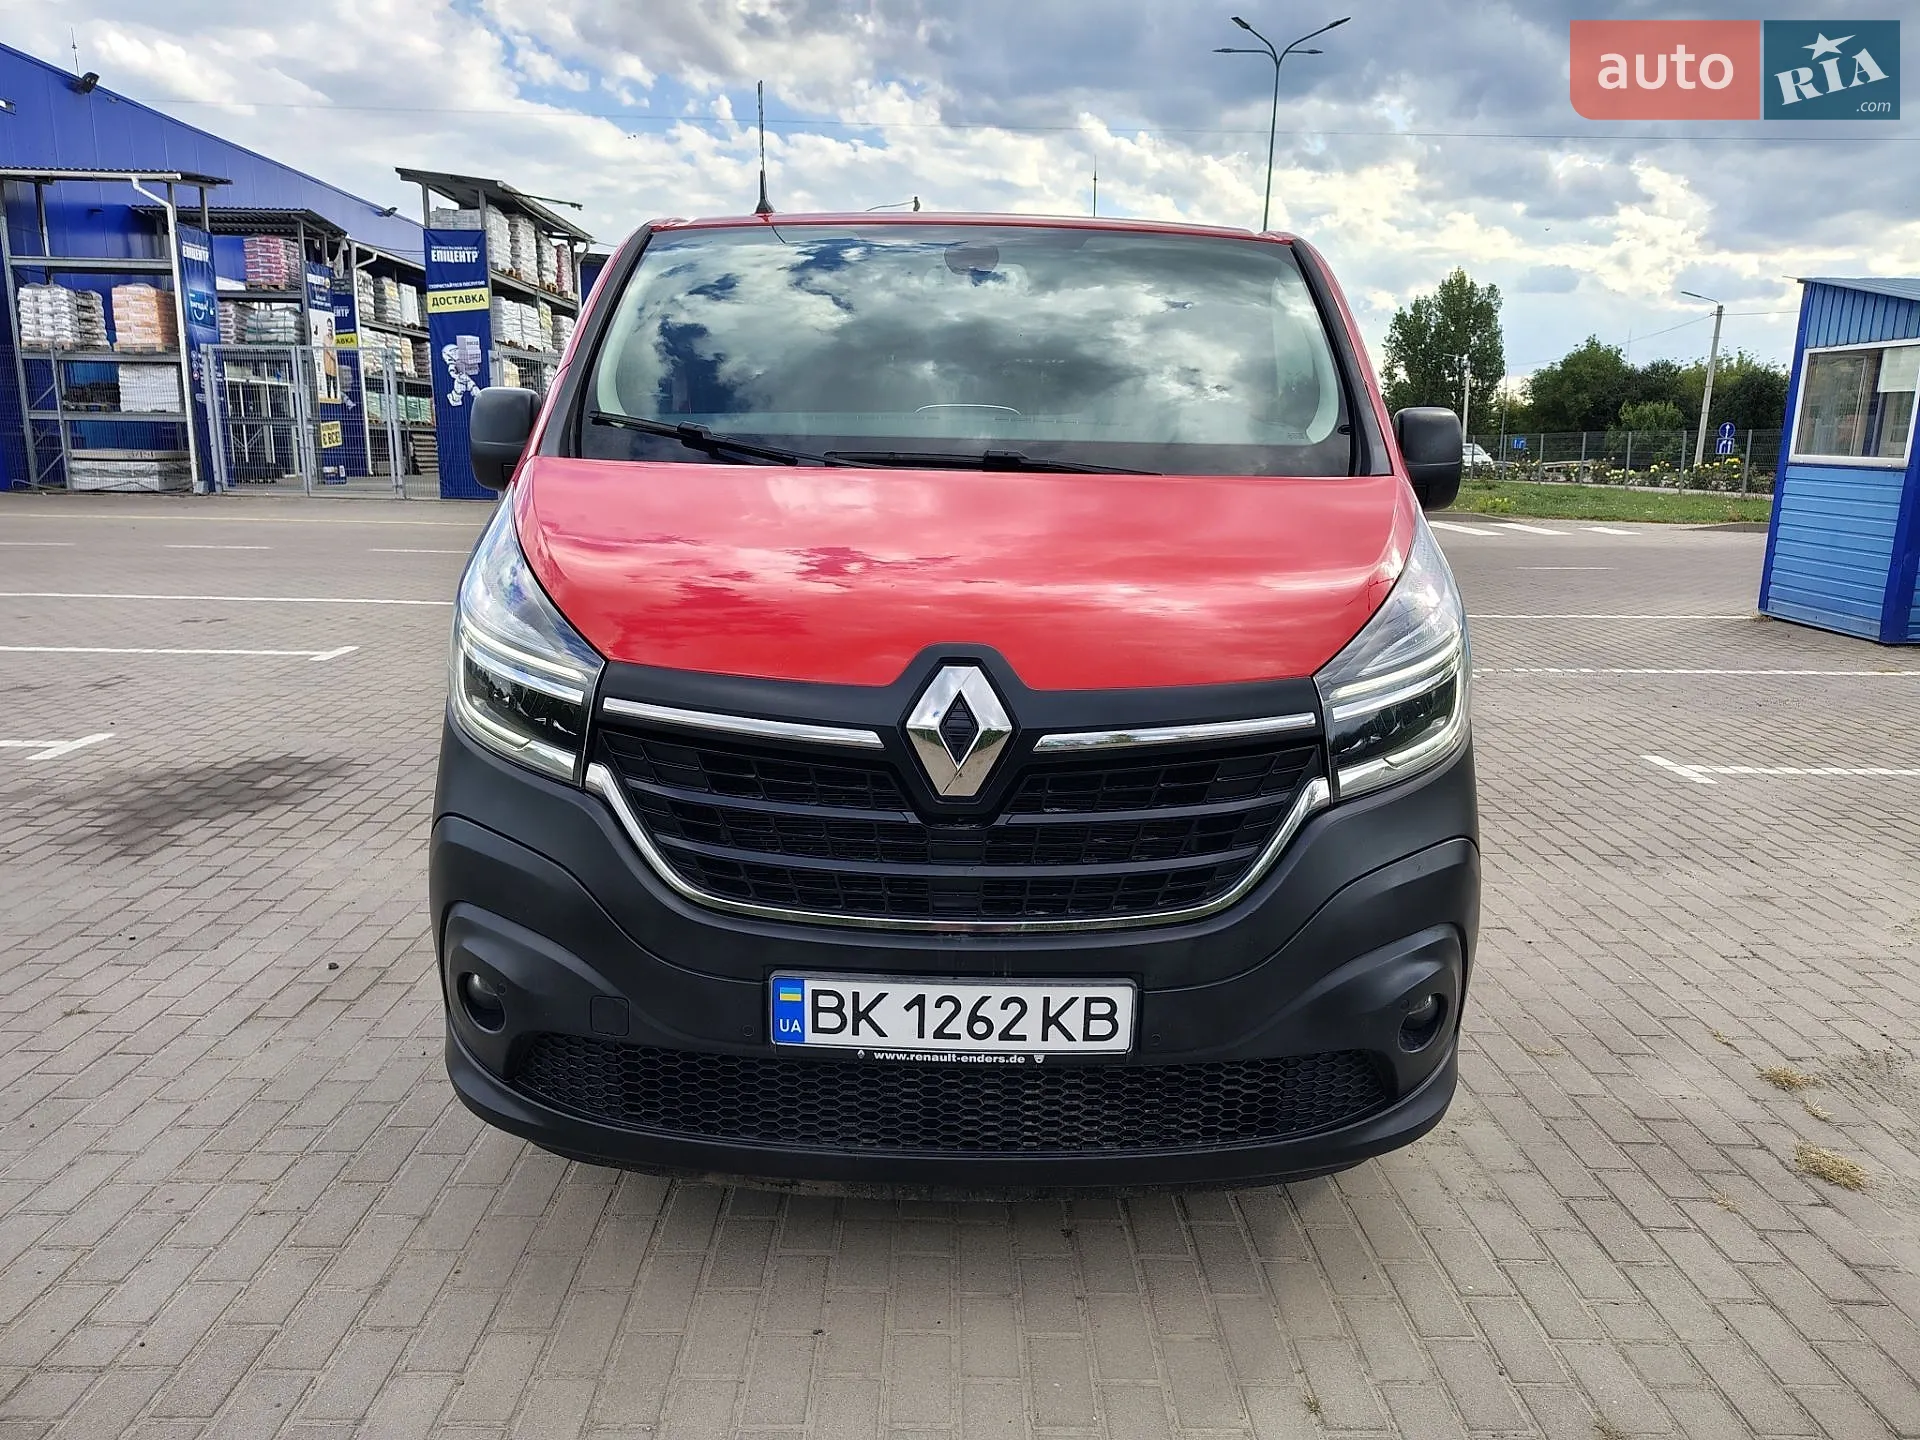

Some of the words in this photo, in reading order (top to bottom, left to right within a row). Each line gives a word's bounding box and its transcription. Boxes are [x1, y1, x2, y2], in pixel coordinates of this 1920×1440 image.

[431, 250, 479, 264] ЕПІЦЕНТР
[431, 293, 486, 307] ДОСТАВКА
[810, 988, 888, 1038] BK
[903, 993, 1028, 1042] 1262
[1041, 996, 1119, 1043] KB
[780, 1019, 801, 1033] UA
[873, 1050, 1026, 1064] www.renault-enders.de
